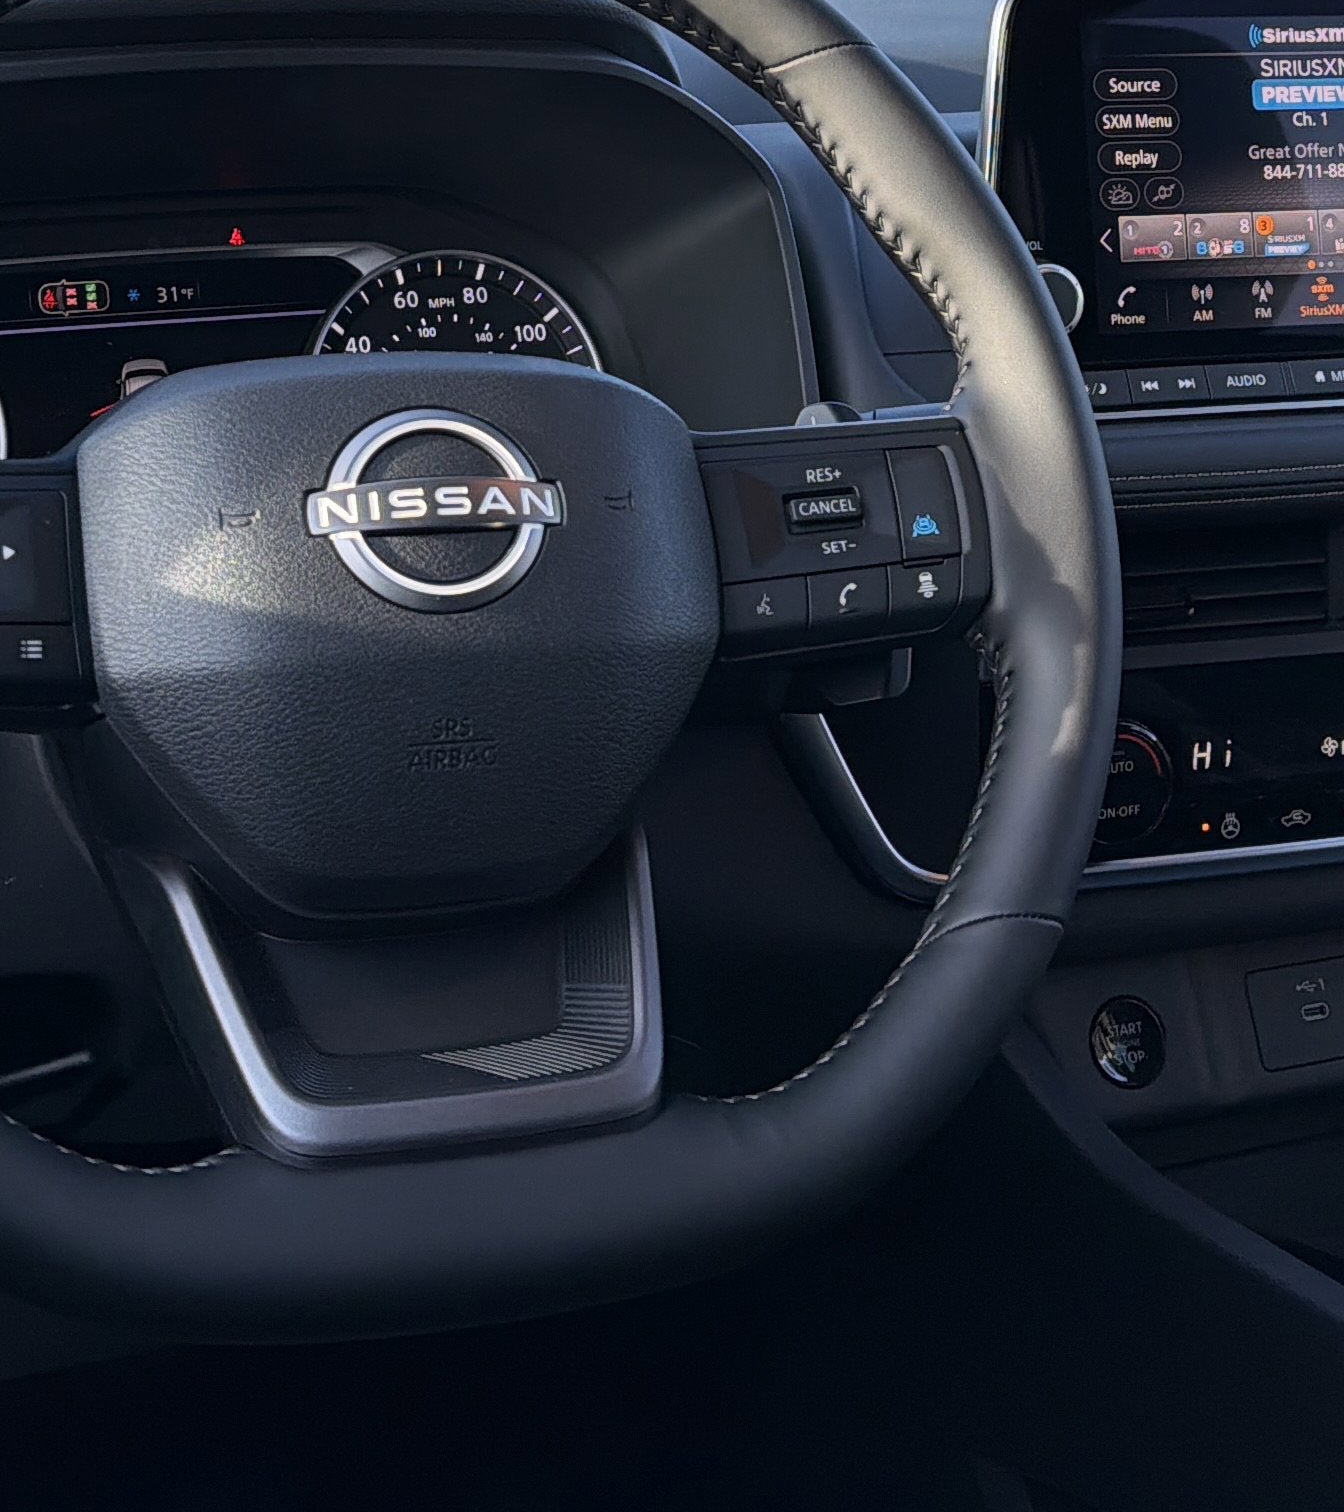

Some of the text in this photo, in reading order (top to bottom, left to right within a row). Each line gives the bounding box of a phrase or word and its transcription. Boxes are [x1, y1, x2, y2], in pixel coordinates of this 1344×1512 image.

[1109, 78, 1161, 93] Source
[1103, 114, 1173, 129] SXM Menu
[1292, 112, 1328, 127] Ch. 1
[1248, 144, 1290, 160] Great
[1294, 142, 1334, 158] Offer
[1115, 150, 1158, 168] Replay
[1173, 221, 1183, 236] 2
[1239, 219, 1250, 234] 8
[1307, 217, 1314, 232] 1
[394, 291, 419, 309] 60
[428, 297, 455, 309] MPH
[463, 287, 488, 304] 80
[1111, 313, 1146, 326] Phone
[1193, 310, 1214, 322] AM
[1255, 307, 1272, 319] FM
[417, 326, 436, 338] 100
[475, 331, 493, 343] 140
[514, 324, 547, 342] 100
[345, 335, 371, 353] 40
[1226, 374, 1266, 388] AUDIO
[806, 468, 842, 484] RES+
[318, 486, 556, 528] NISSAN
[799, 498, 856, 516] CANCEL
[1192, 739, 1232, 770] Hi
[1109, 761, 1134, 774] UTO
